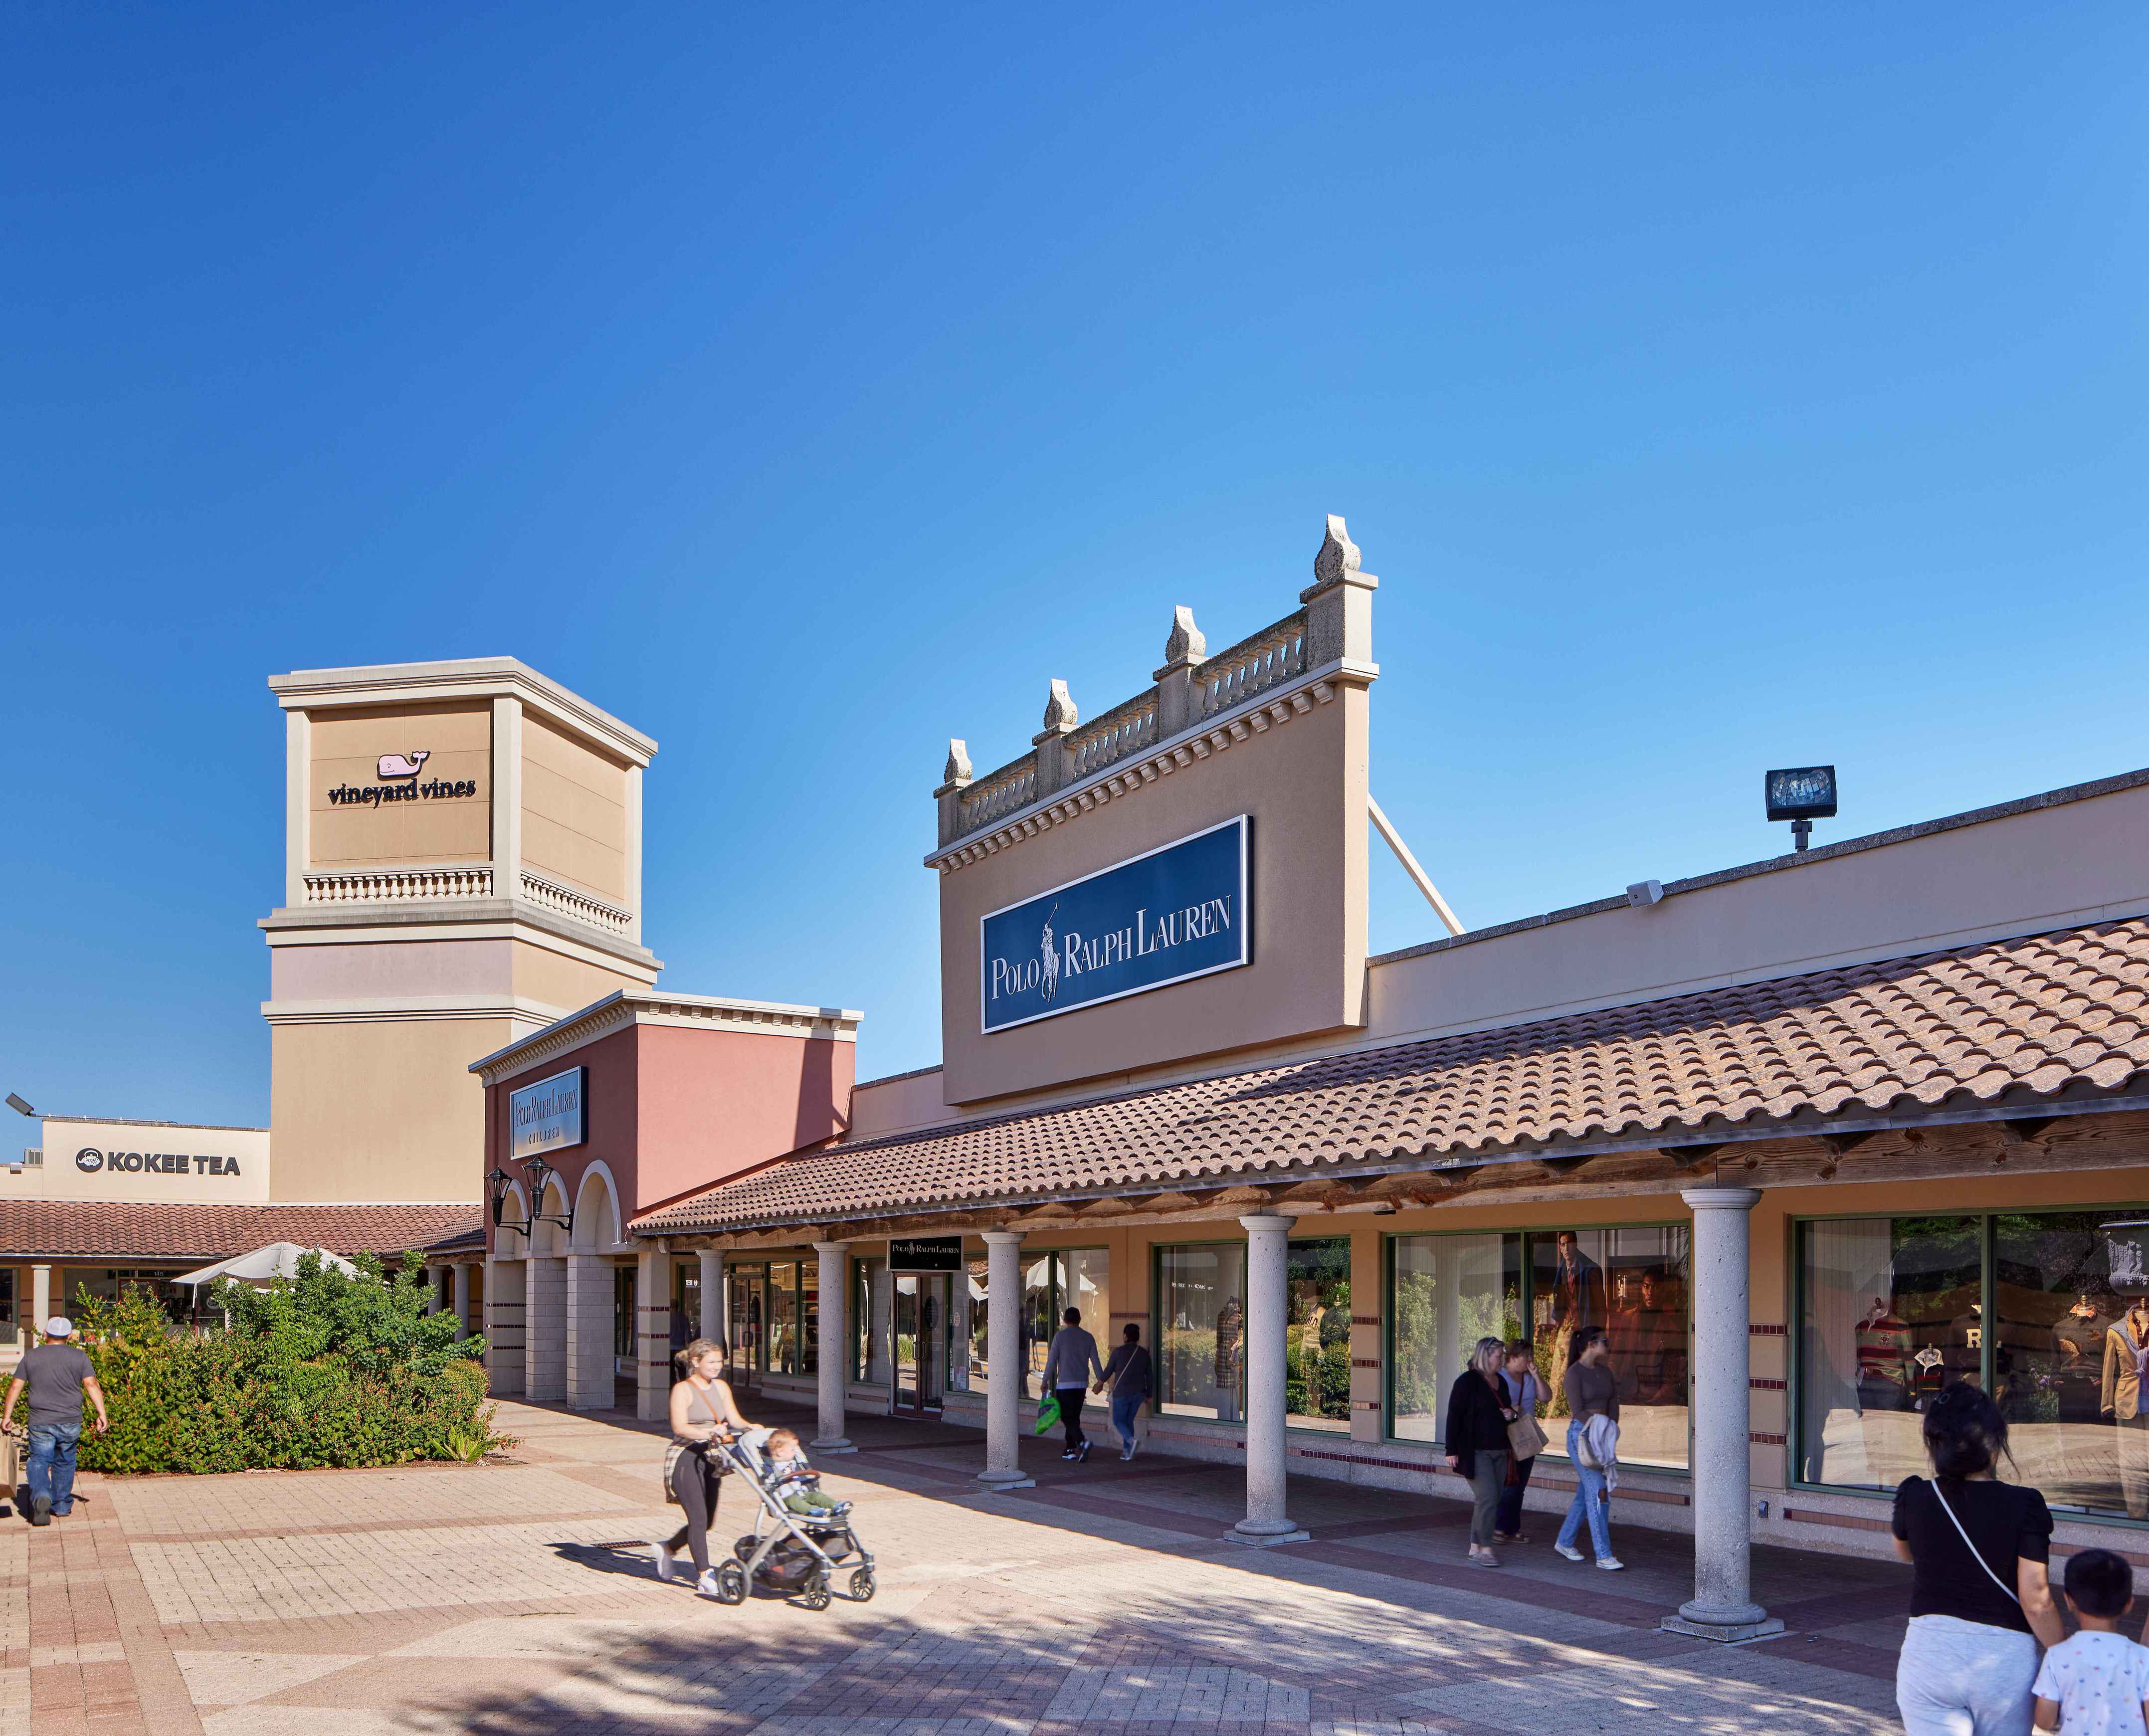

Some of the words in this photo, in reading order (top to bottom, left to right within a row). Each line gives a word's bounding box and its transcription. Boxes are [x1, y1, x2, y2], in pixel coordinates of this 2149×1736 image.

[328, 778, 418, 809] vineyard
[419, 777, 476, 799] vines
[992, 958, 1040, 1000] POLO
[1064, 927, 1132, 978] RALPH
[1136, 895, 1231, 957] LAUREN
[515, 1101, 531, 1127] POLO
[528, 1126, 559, 1145] CHILDREN
[108, 1152, 189, 1174] KOKEE
[193, 1155, 240, 1176] TEA
